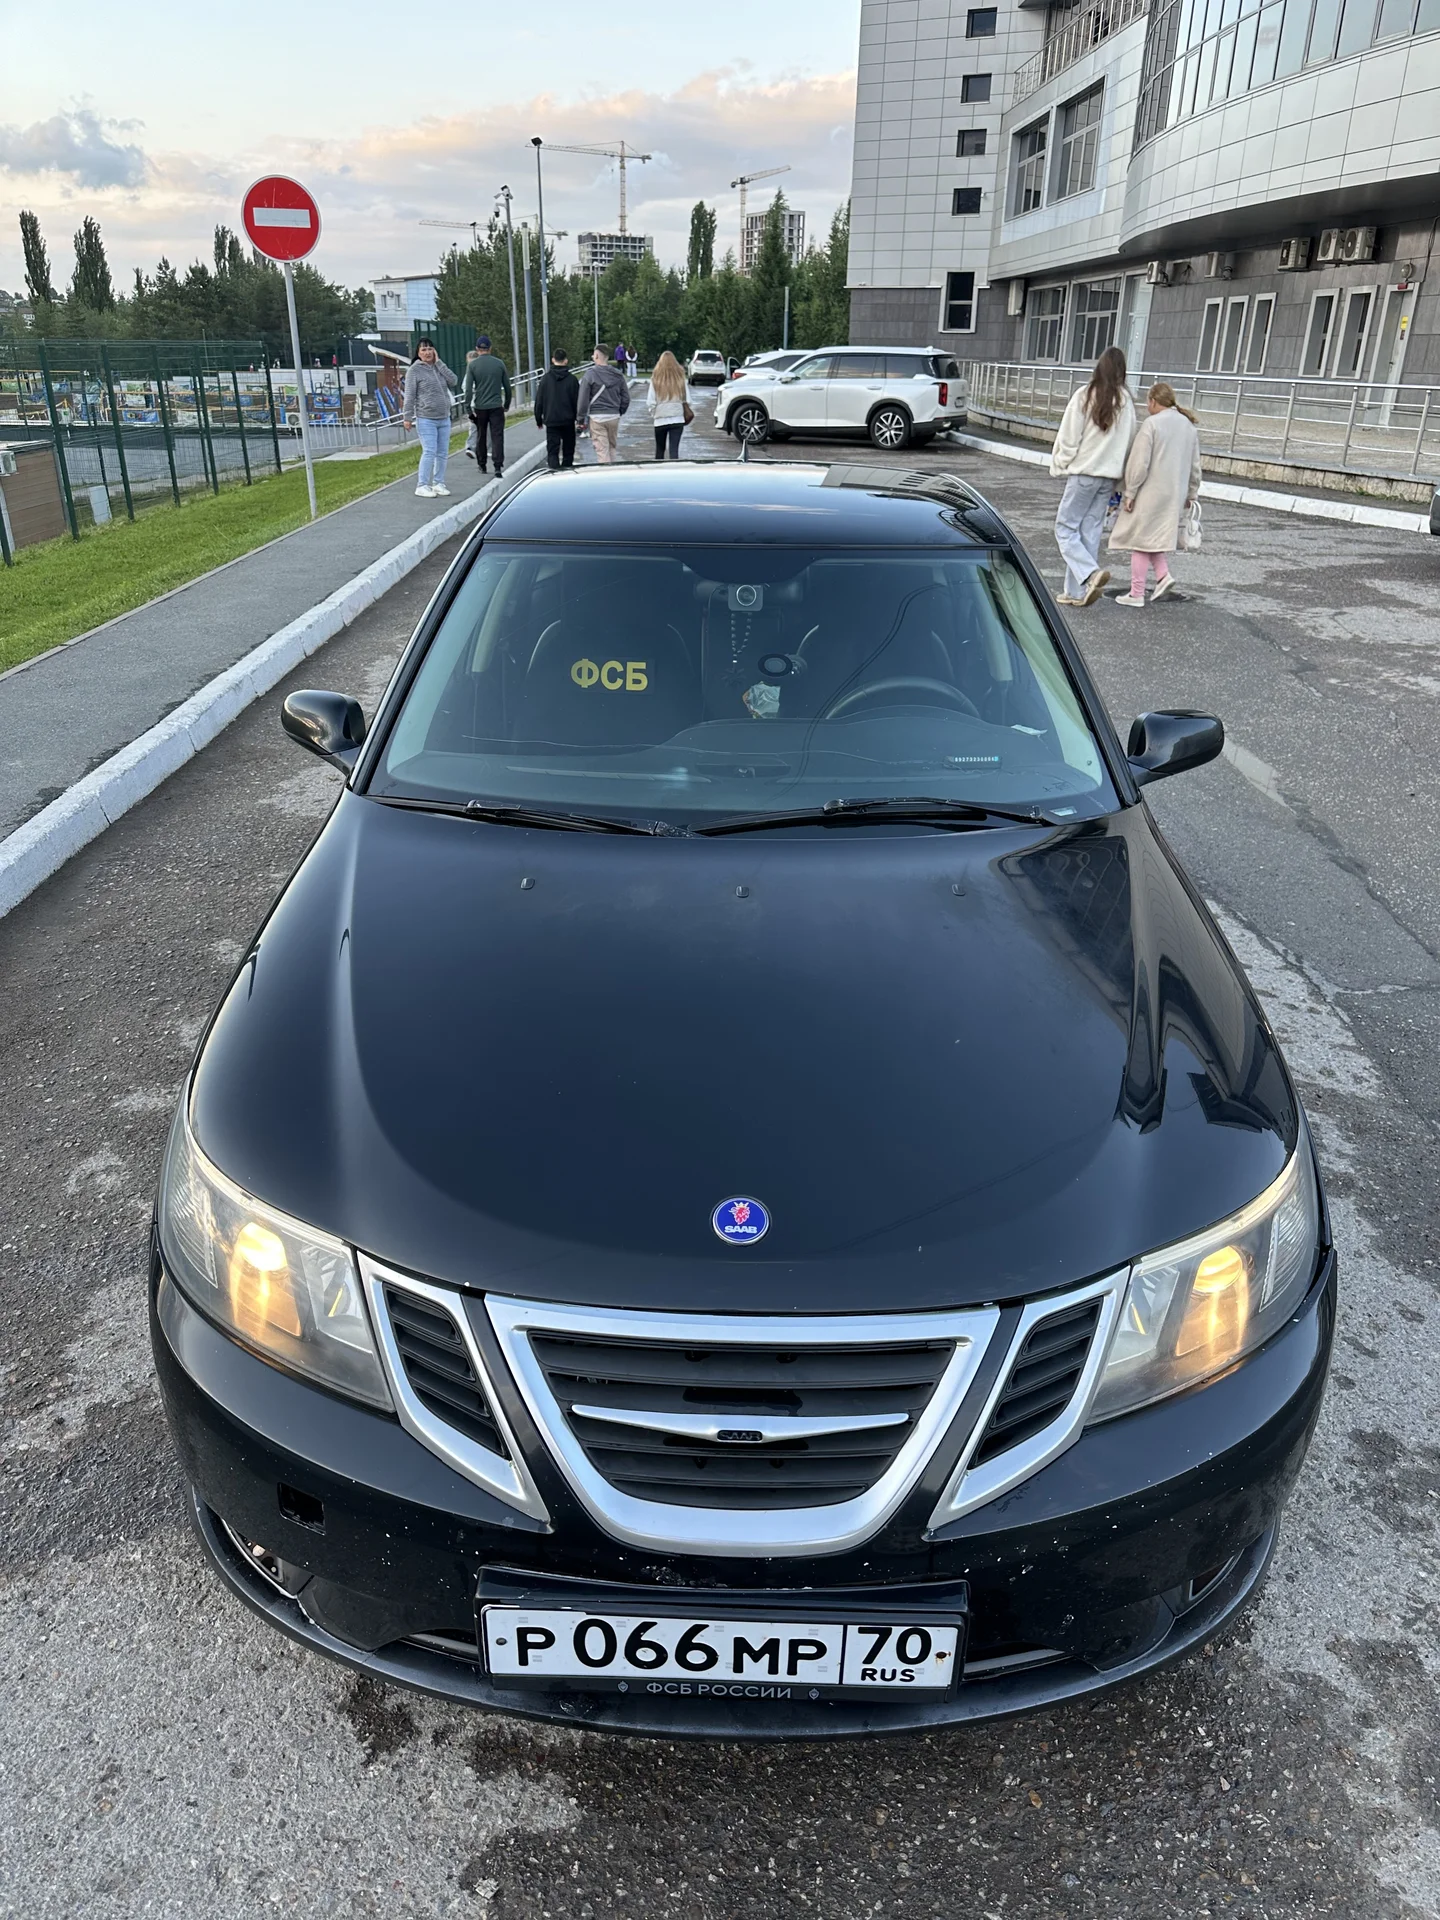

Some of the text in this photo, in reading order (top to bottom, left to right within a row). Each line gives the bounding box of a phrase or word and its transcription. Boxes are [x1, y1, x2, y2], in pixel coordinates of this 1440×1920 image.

[570, 658, 649, 692] ФСБ
[724, 1225, 758, 1234] SAAB
[857, 1626, 933, 1666] 70
[859, 1667, 916, 1683] RUS
[645, 1681, 792, 1699] ФСБ РОССИИ
